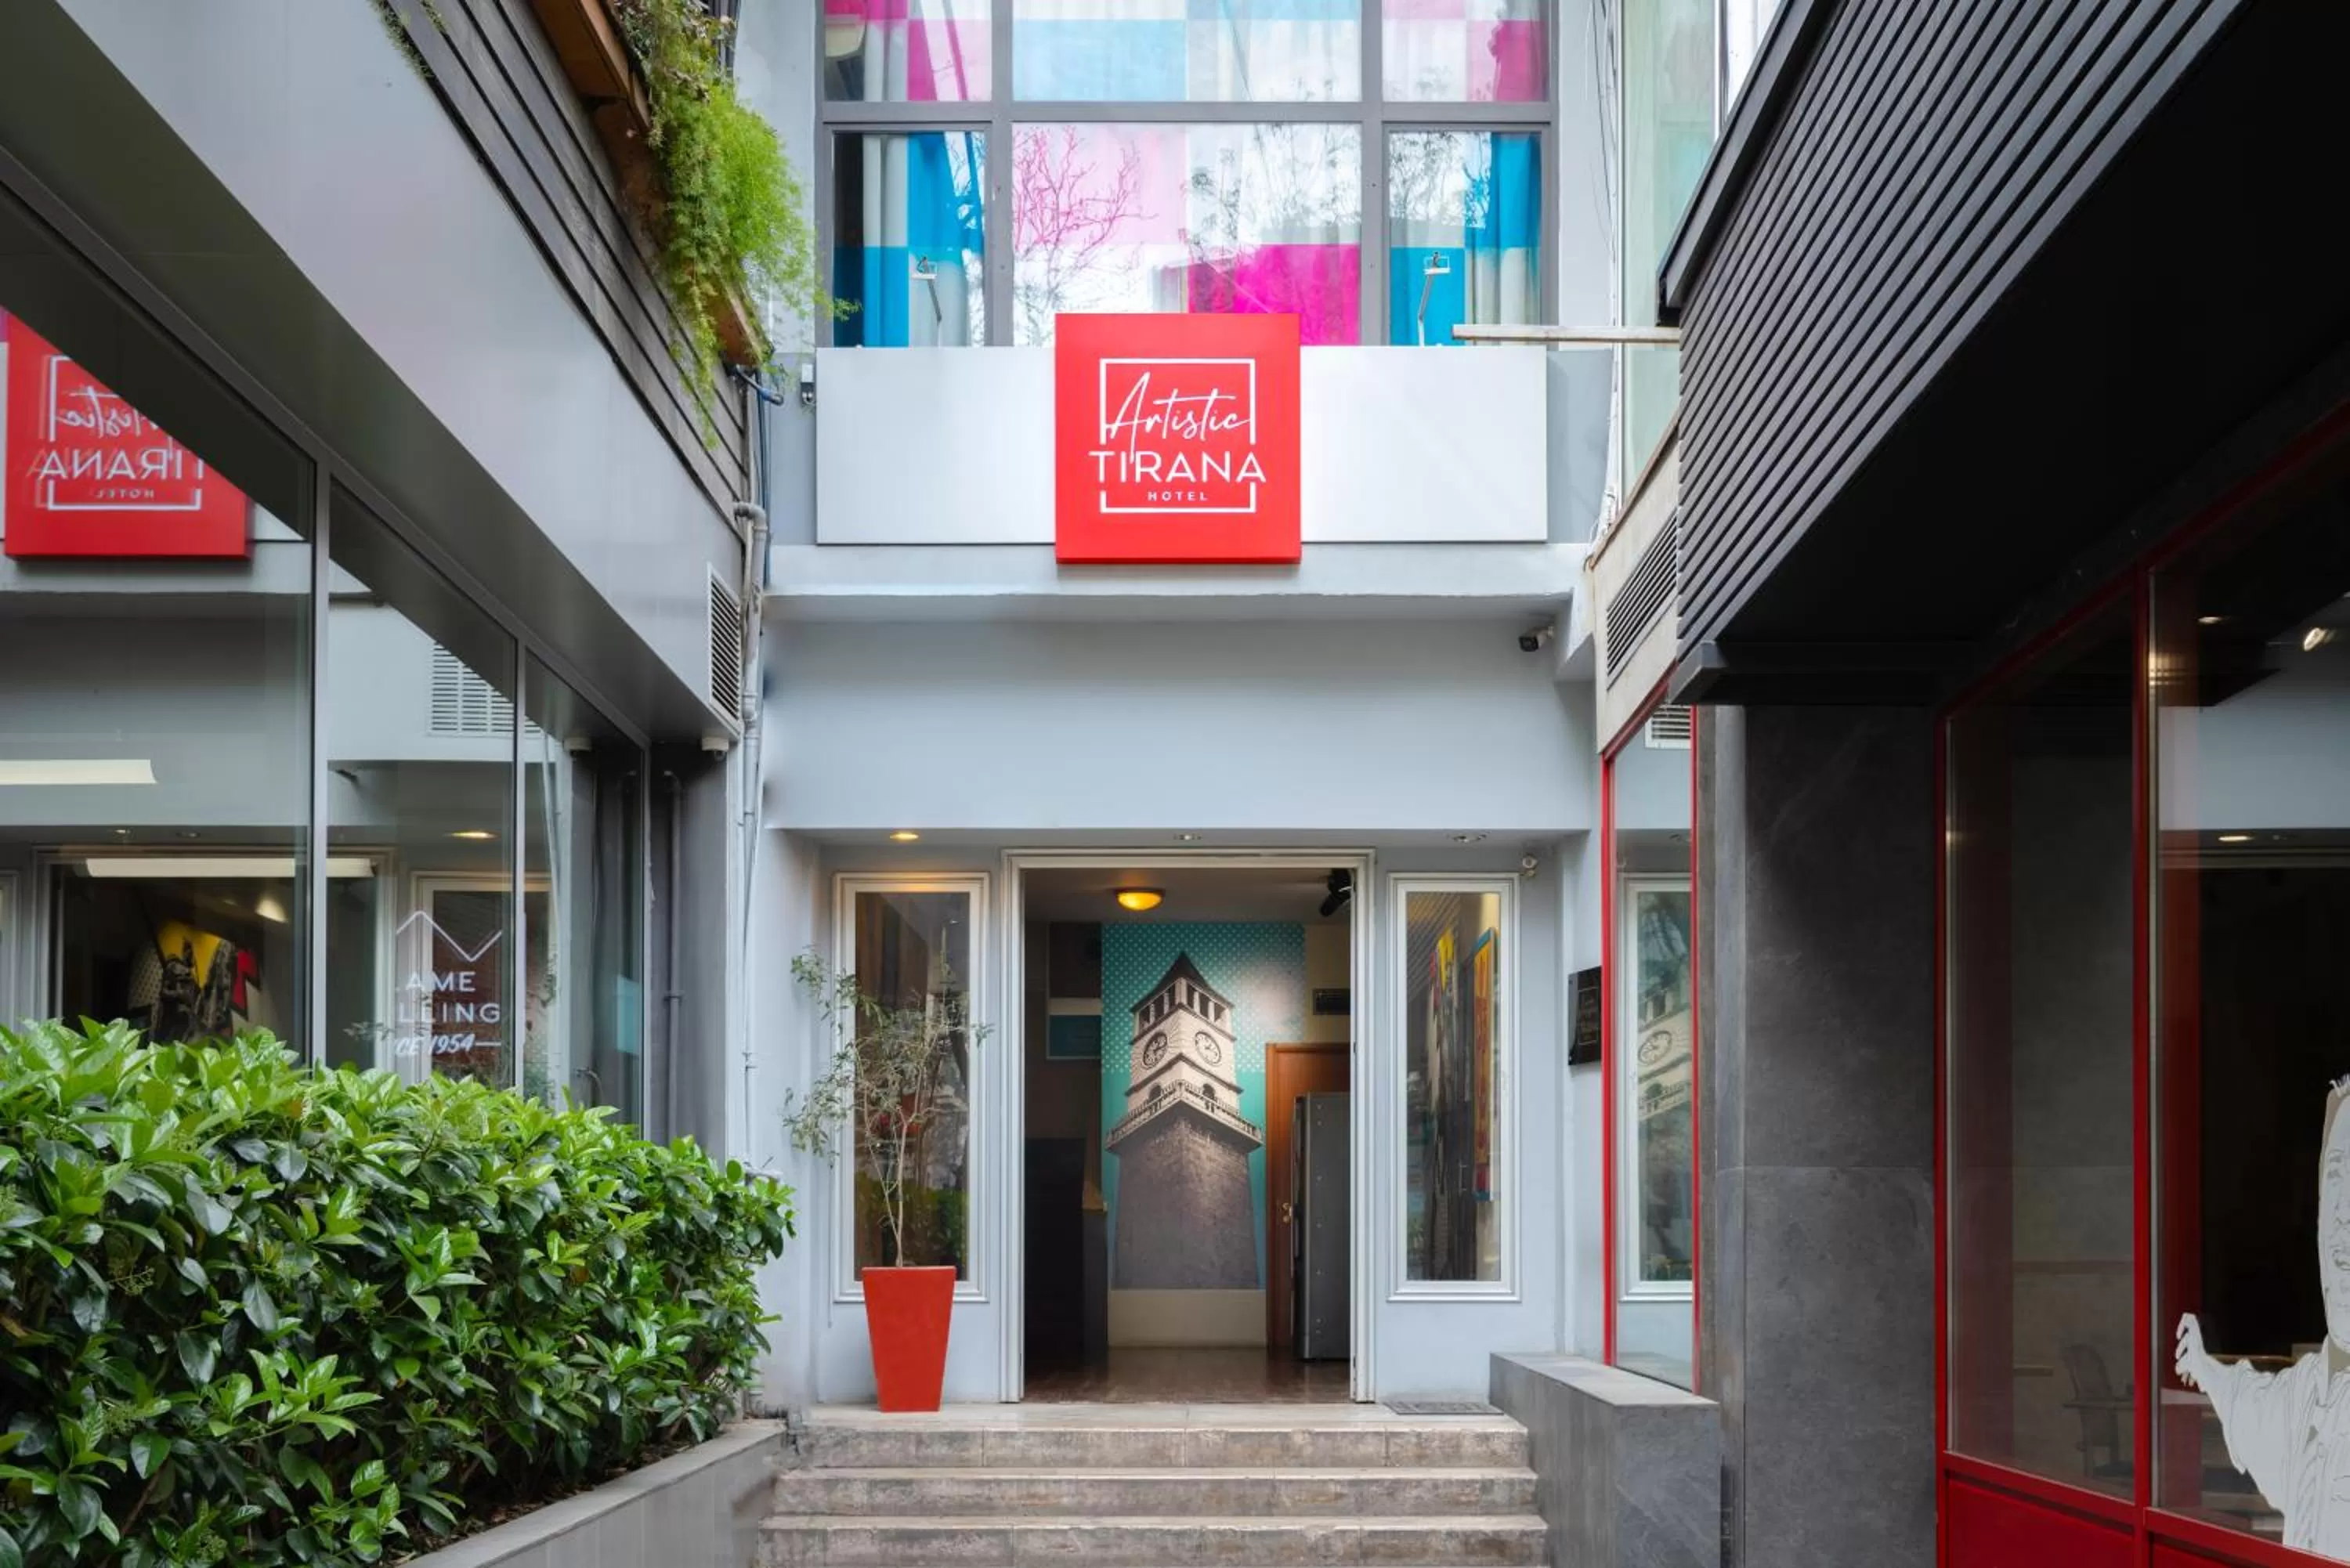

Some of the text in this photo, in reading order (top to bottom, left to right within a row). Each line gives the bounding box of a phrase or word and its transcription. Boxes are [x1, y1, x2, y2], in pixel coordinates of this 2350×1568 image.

[1105, 372, 1250, 464] Artistic
[1088, 450, 1267, 483] TIRANA
[1148, 491, 1209, 501] HOTEL
[395, 971, 476, 992] AME
[428, 1033, 476, 1055] 1954
